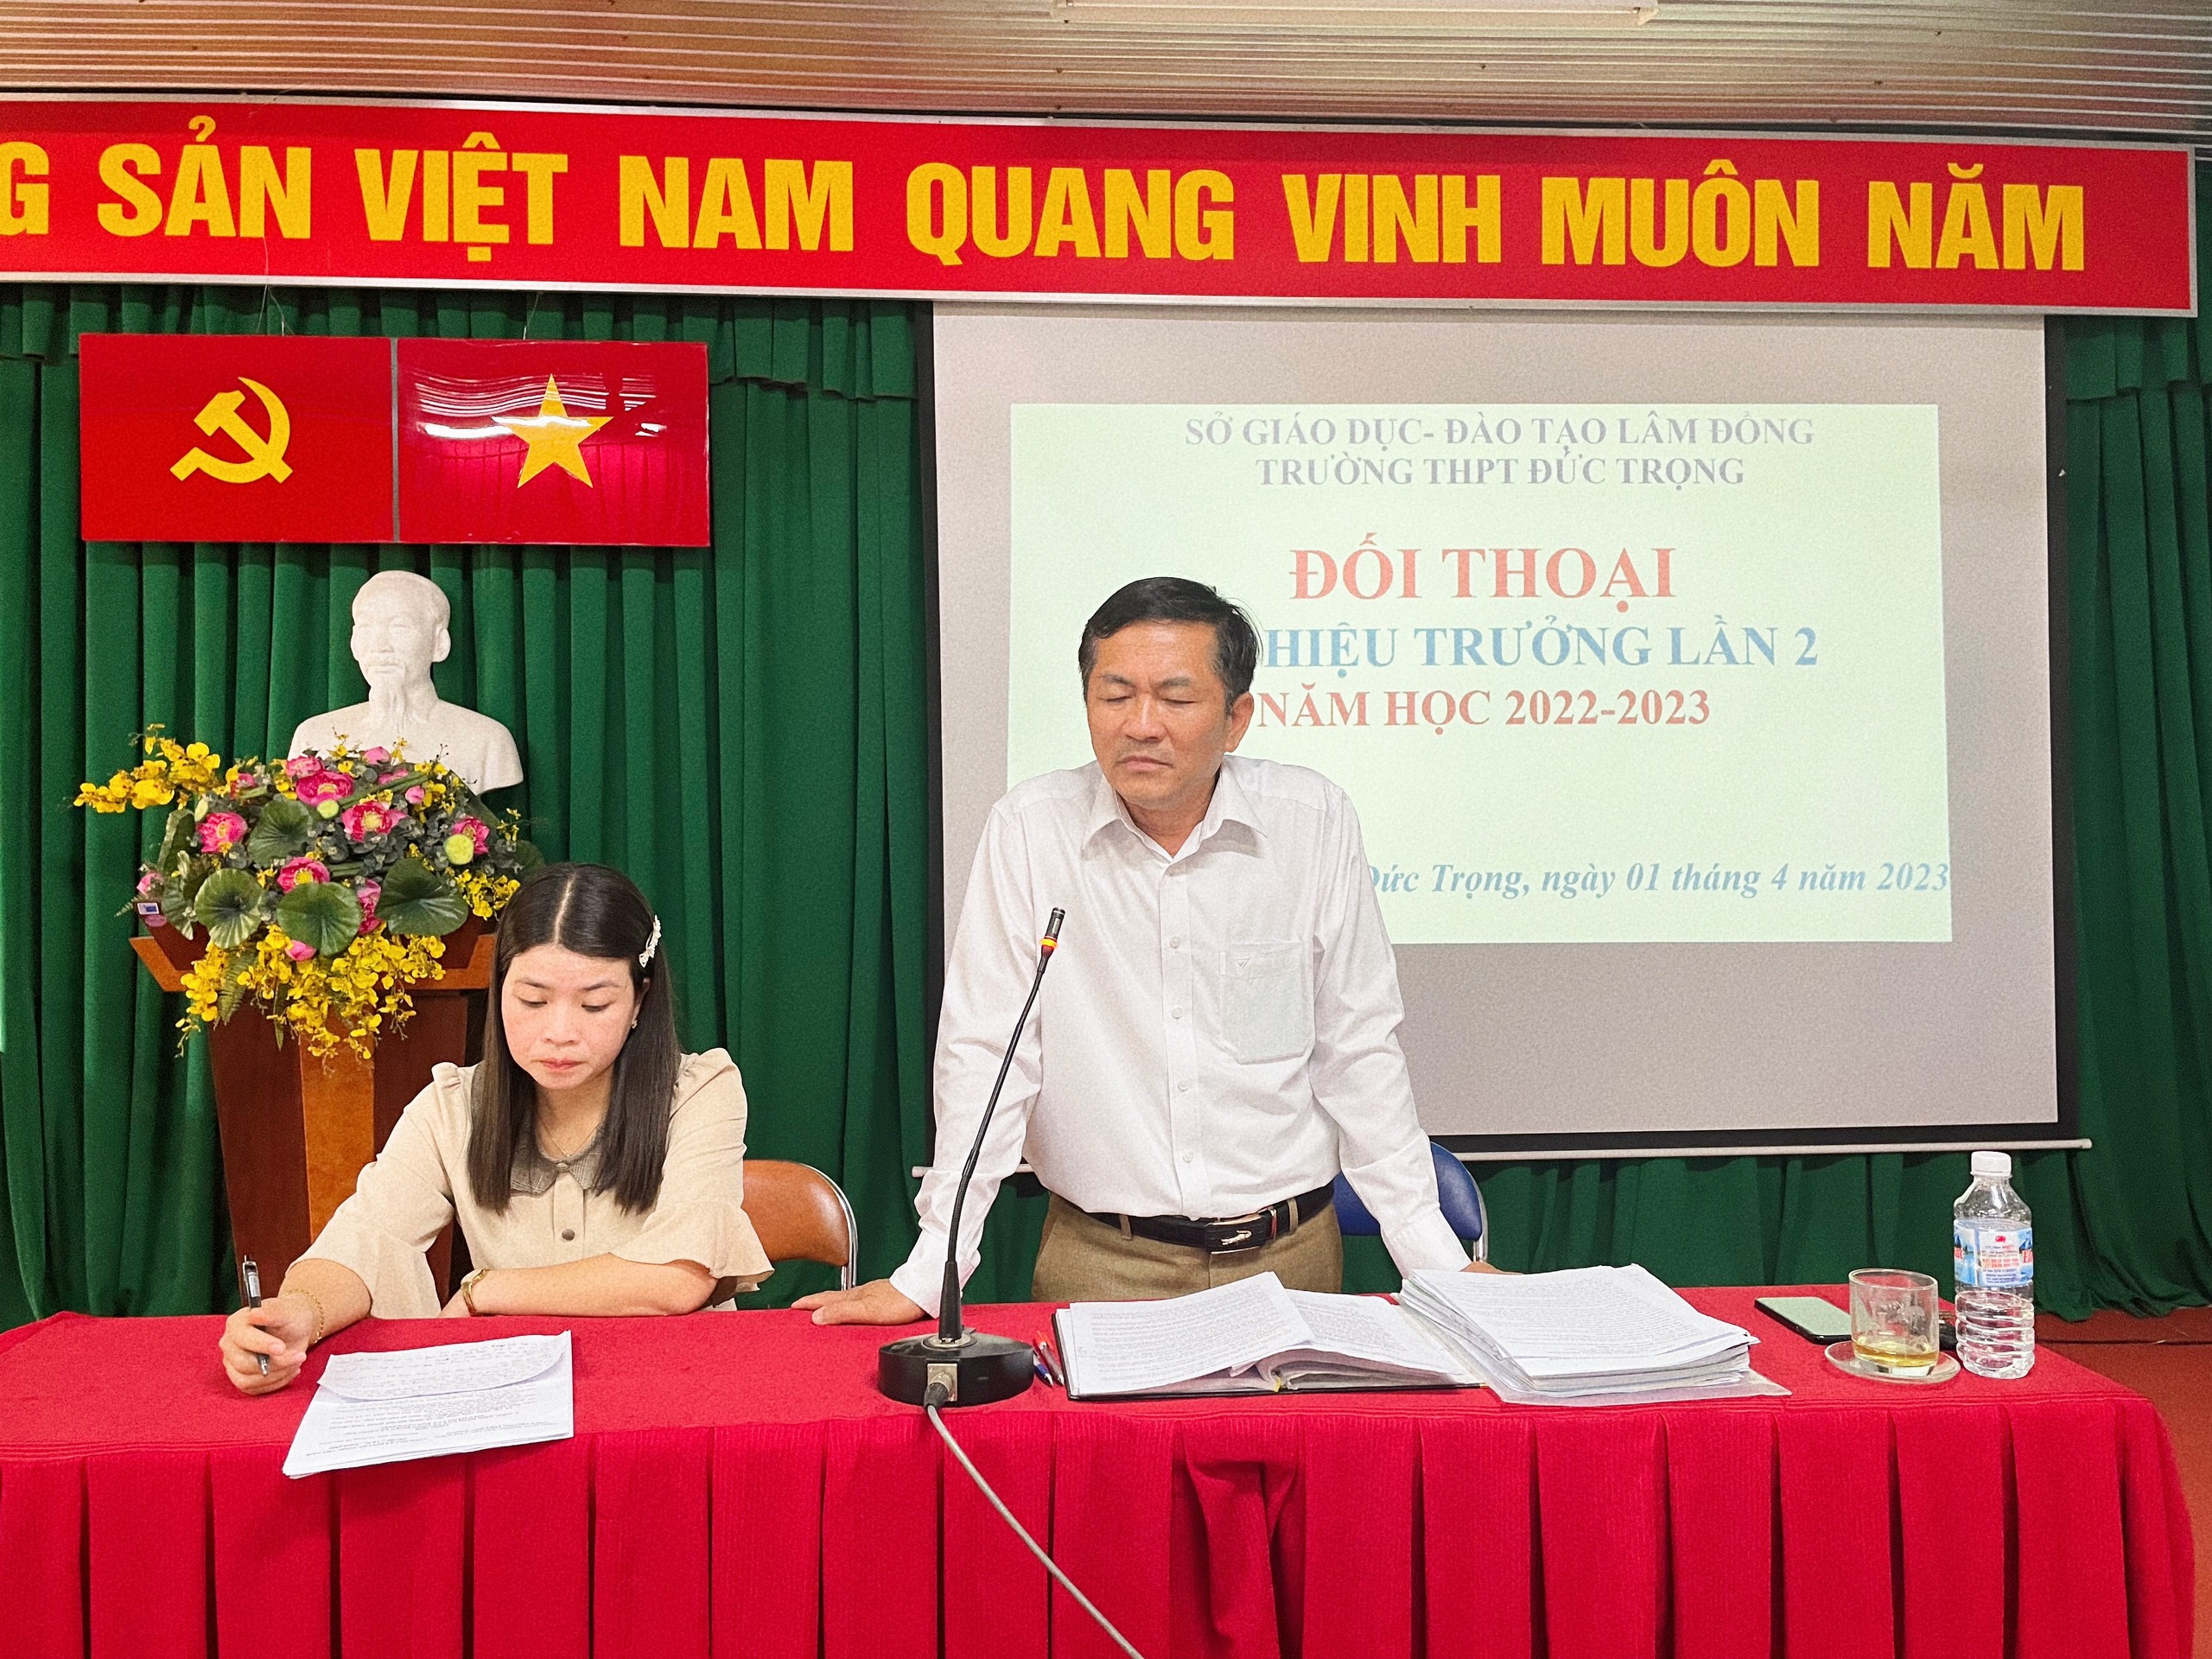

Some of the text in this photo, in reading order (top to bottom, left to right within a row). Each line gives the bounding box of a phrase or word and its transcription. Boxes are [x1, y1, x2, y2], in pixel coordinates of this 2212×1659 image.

[0, 115, 2084, 271] G SẢN VIỆT NAM QUANG VINH MUÔN NĂM
[1185, 410, 1233, 445] SỞ
[1243, 411, 1336, 445] GIÁO
[1346, 418, 1434, 452] DỤC-
[1444, 411, 1522, 444] ĐÀO
[1531, 418, 1606, 452] TẠO
[1616, 410, 1698, 444] LÂM
[1255, 448, 1745, 491] TRƯỜNG THPT ĐỨC TRỌNG
[1288, 532, 1677, 613] ĐỐI THOẠI
[1264, 614, 1818, 678] HIỆU TRƯỞNG LẦN 2
[1256, 682, 1711, 736] NĂM HỌC 2022-2023
[1431, 863, 1529, 900] Trọng,
[1541, 862, 1616, 900] ngày
[1626, 862, 1660, 892] 01
[1671, 862, 1762, 899] tháng
[1770, 862, 1789, 892] 4
[1797, 863, 1866, 892] năm
[1876, 862, 1949, 892] 2023
